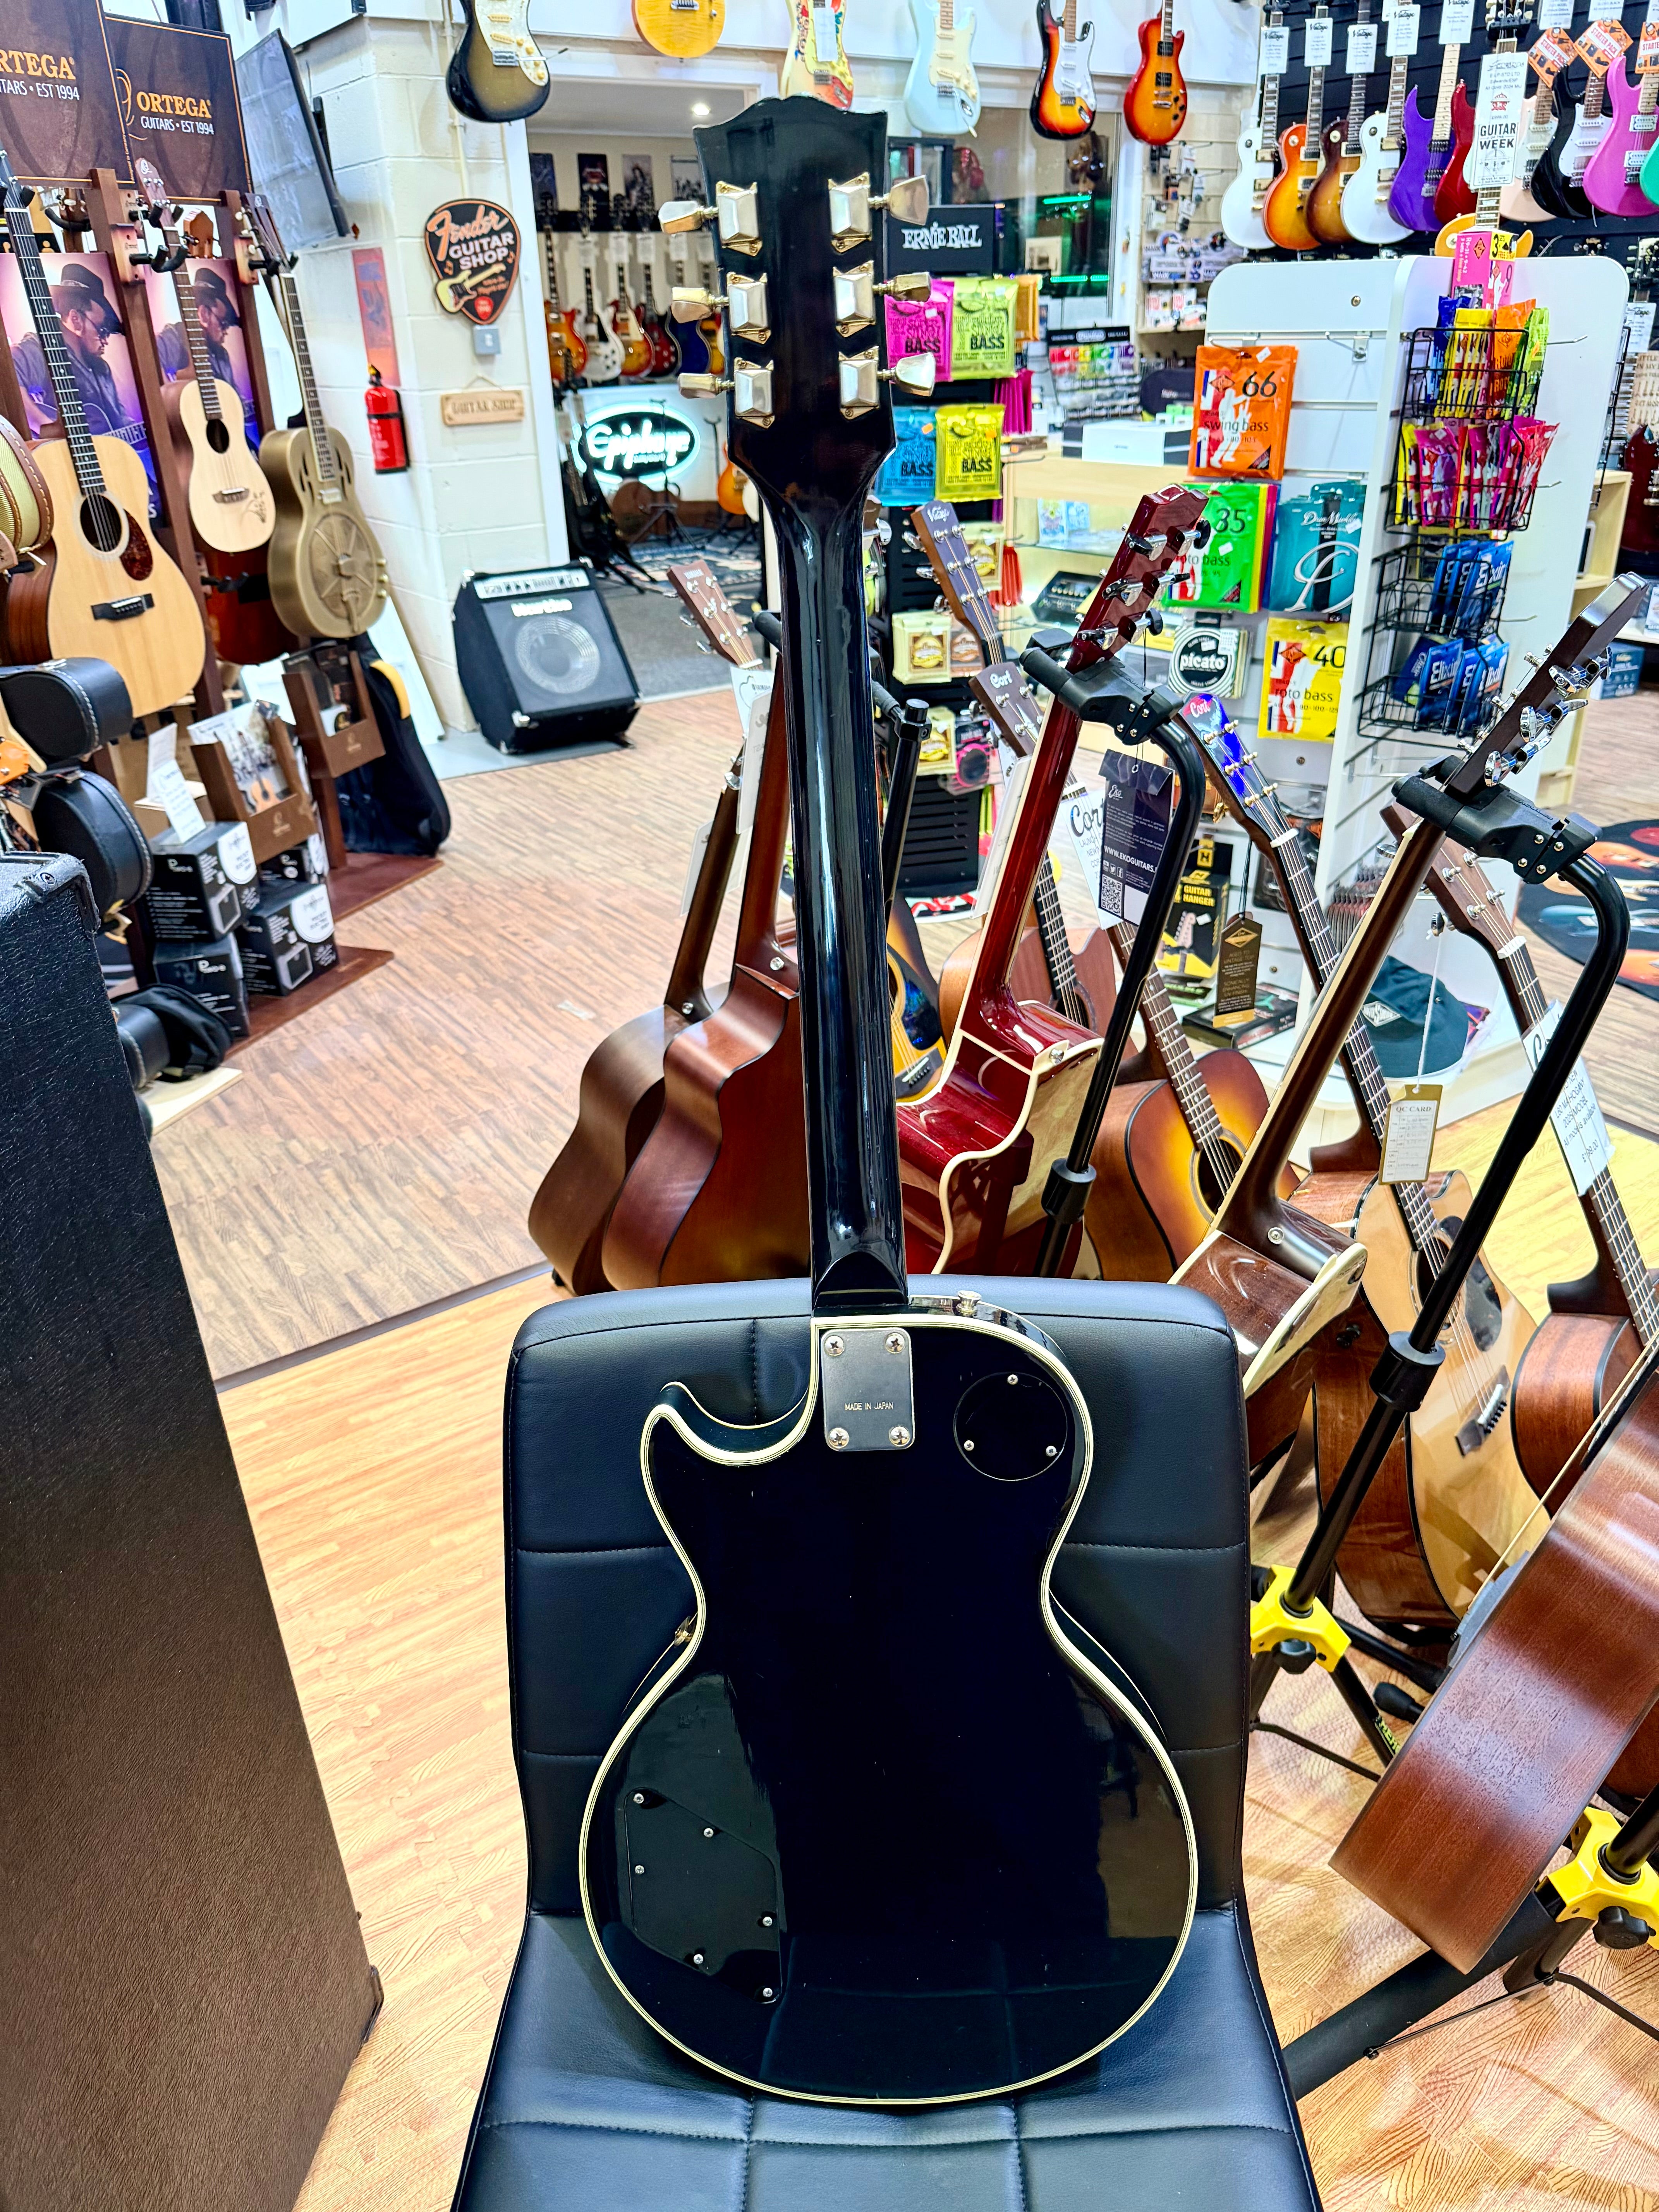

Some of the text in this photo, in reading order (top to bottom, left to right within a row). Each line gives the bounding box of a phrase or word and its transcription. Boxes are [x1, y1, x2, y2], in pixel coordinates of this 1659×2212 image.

[1540, 39, 1558, 56] STARTER
[1591, 27, 1618, 55] STARTER PACK
[36, 83, 53, 98] EST
[55, 84, 80, 100] 1994
[136, 91, 212, 118] ORTEGA
[141, 116, 214, 135] GUITARS EST 1994
[1480, 122, 1516, 137] GUITAR
[1479, 138, 1515, 150] WEEK
[426, 204, 510, 261] Fender
[945, 225, 982, 249] BALL
[448, 232, 515, 259] GUITAR
[1492, 234, 1499, 258] 3
[459, 247, 508, 270] SHOP
[1506, 264, 1513, 293] 9
[905, 337, 941, 353] BASS
[970, 335, 1005, 349] BASS
[1242, 371, 1278, 397] 66
[1204, 417, 1269, 434] swing bass
[901, 461, 934, 476] BASS
[962, 458, 992, 472] BASS
[928, 505, 950, 522] Vintage
[1214, 508, 1247, 533] 35
[1202, 553, 1231, 567] bass
[1180, 651, 1226, 672] picato
[1312, 645, 1347, 668] 40
[989, 670, 1013, 689] Cort
[1275, 687, 1333, 702] roto bass
[1190, 699, 1211, 718] Cort
[1108, 784, 1123, 799] Eko
[1086, 847, 1097, 857] NEW
[1183, 884, 1212, 897] GUITAR
[1183, 893, 1215, 907] HANGER
[1561, 1076, 1585, 1109] MAHOGANY
[1572, 1095, 1588, 1117] MODEL
[845, 1403, 863, 1411] MADE
[874, 1401, 894, 1410] JAPAN
